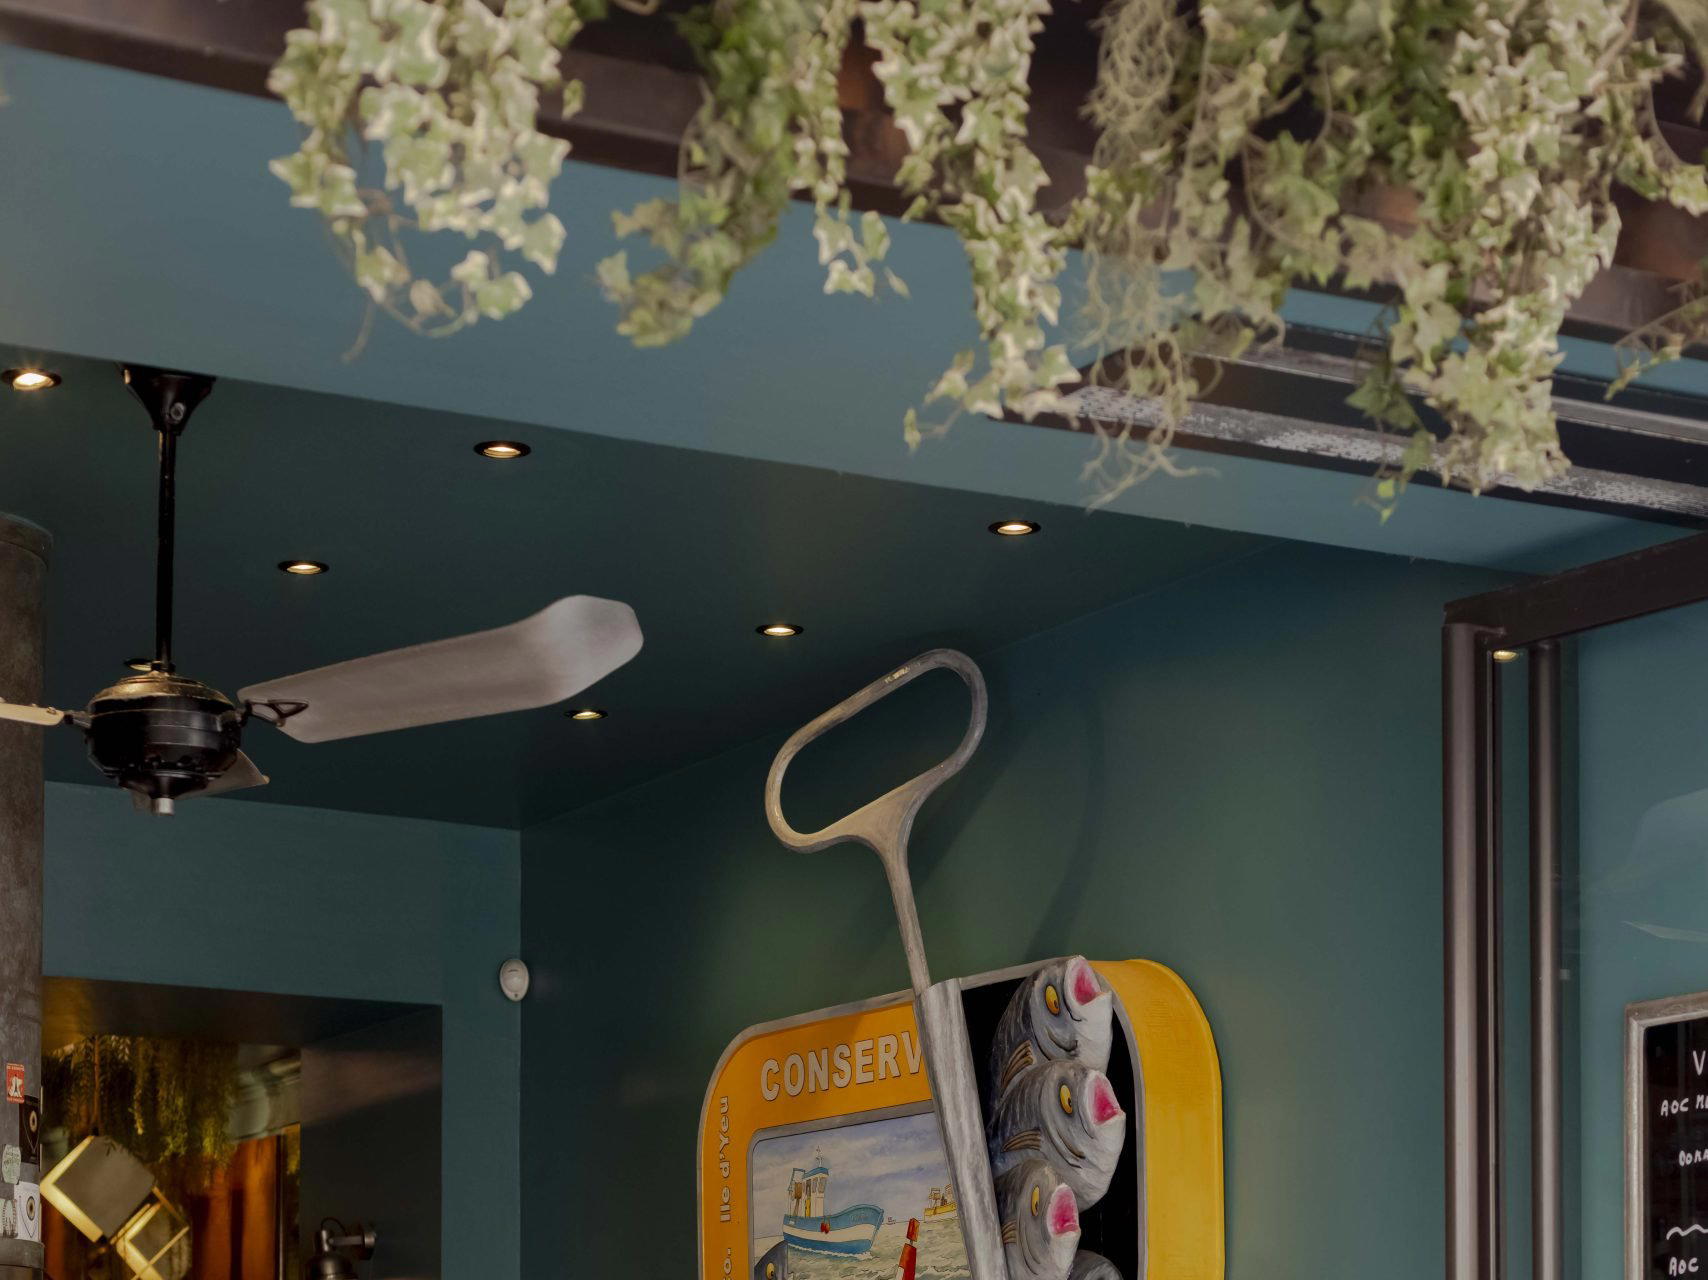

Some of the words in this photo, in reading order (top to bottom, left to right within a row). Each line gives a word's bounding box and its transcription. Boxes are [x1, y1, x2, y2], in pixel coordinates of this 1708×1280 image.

[1661, 1097, 1690, 1117] AOC
[719, 1095, 731, 1179] d'Yeu
[1669, 1256, 1699, 1277] AOC
